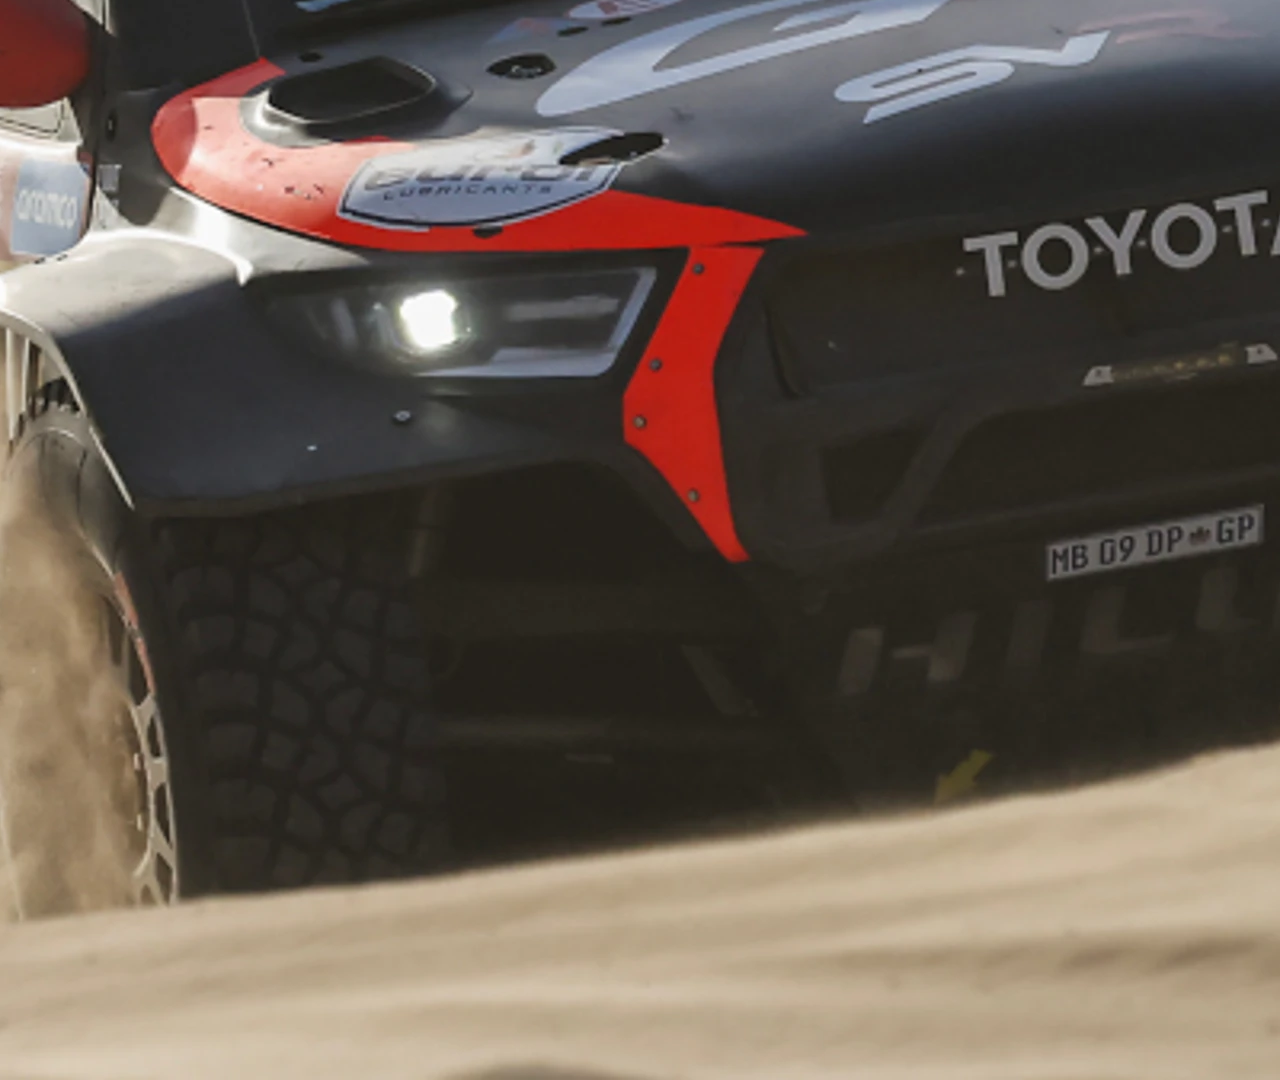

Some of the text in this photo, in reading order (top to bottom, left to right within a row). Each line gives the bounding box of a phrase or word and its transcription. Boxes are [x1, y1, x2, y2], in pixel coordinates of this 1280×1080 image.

[16, 189, 78, 229] aramco
[383, 183, 552, 202] LUBRICANTS
[1049, 512, 1256, 574] MB 09 DP GP
